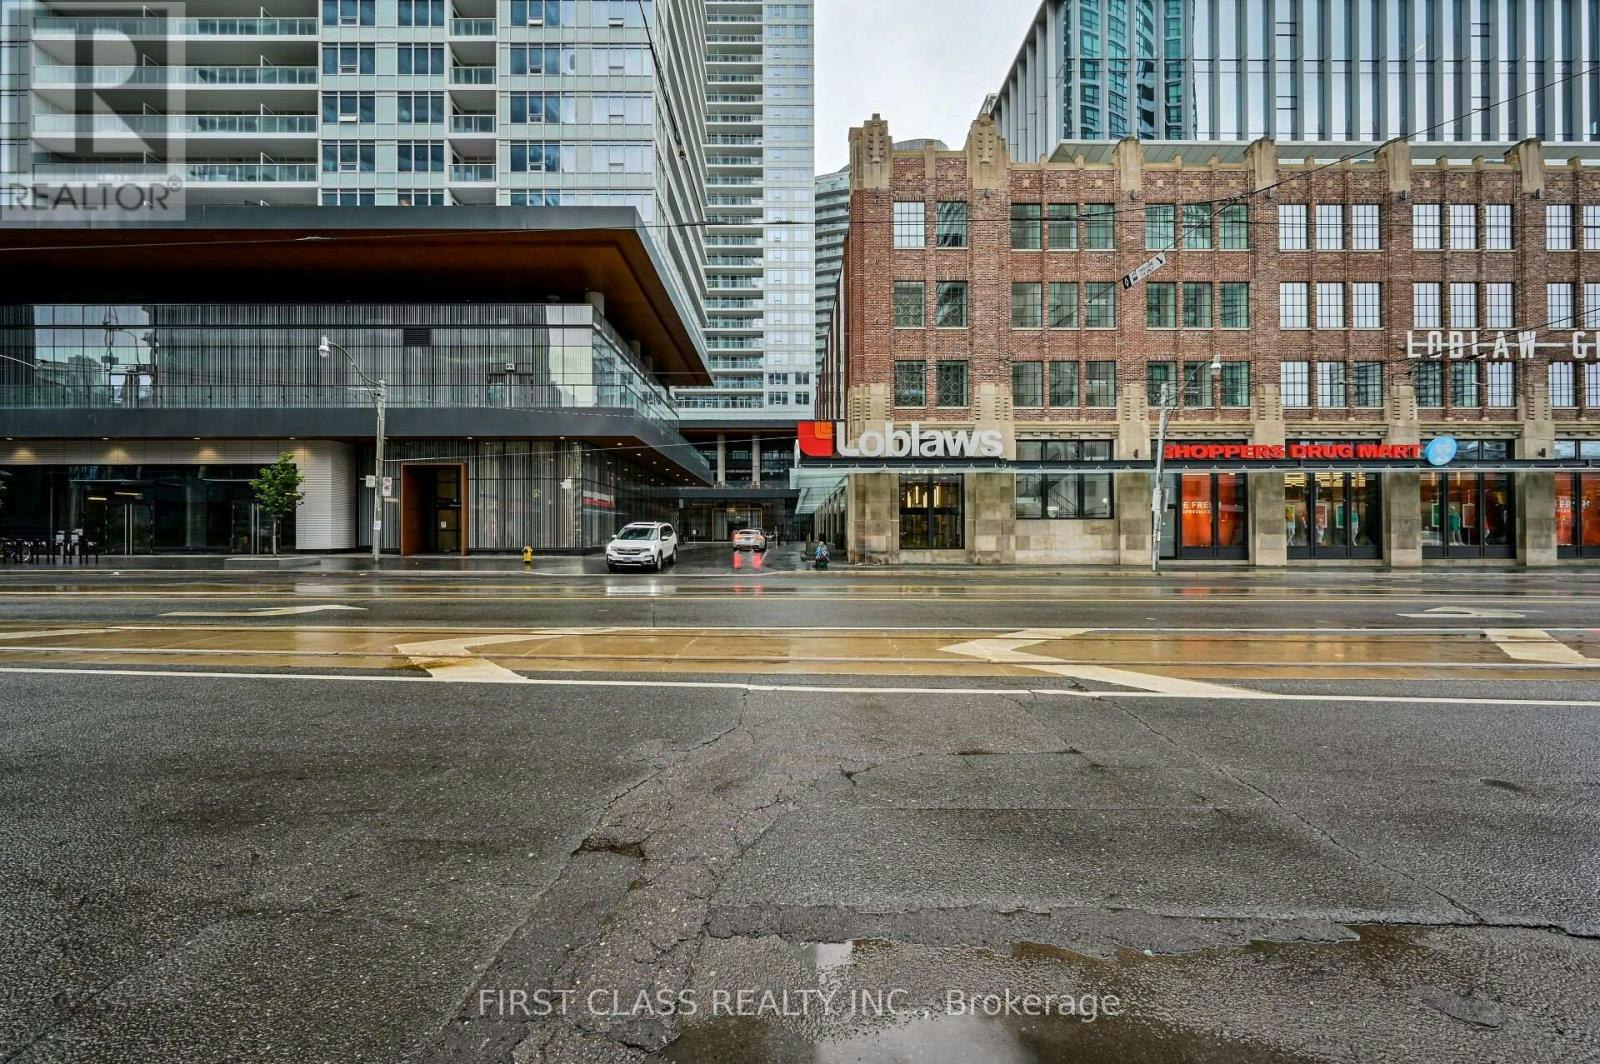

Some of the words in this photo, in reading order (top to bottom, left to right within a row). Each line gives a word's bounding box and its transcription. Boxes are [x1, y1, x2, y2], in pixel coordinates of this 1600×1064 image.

[1407, 330, 1537, 359] LOBLAW
[836, 421, 1004, 458] Loblaws
[1164, 444, 1285, 459] SHOPPERS
[1290, 443, 1354, 459] DRUG
[1356, 443, 1423, 459] MART
